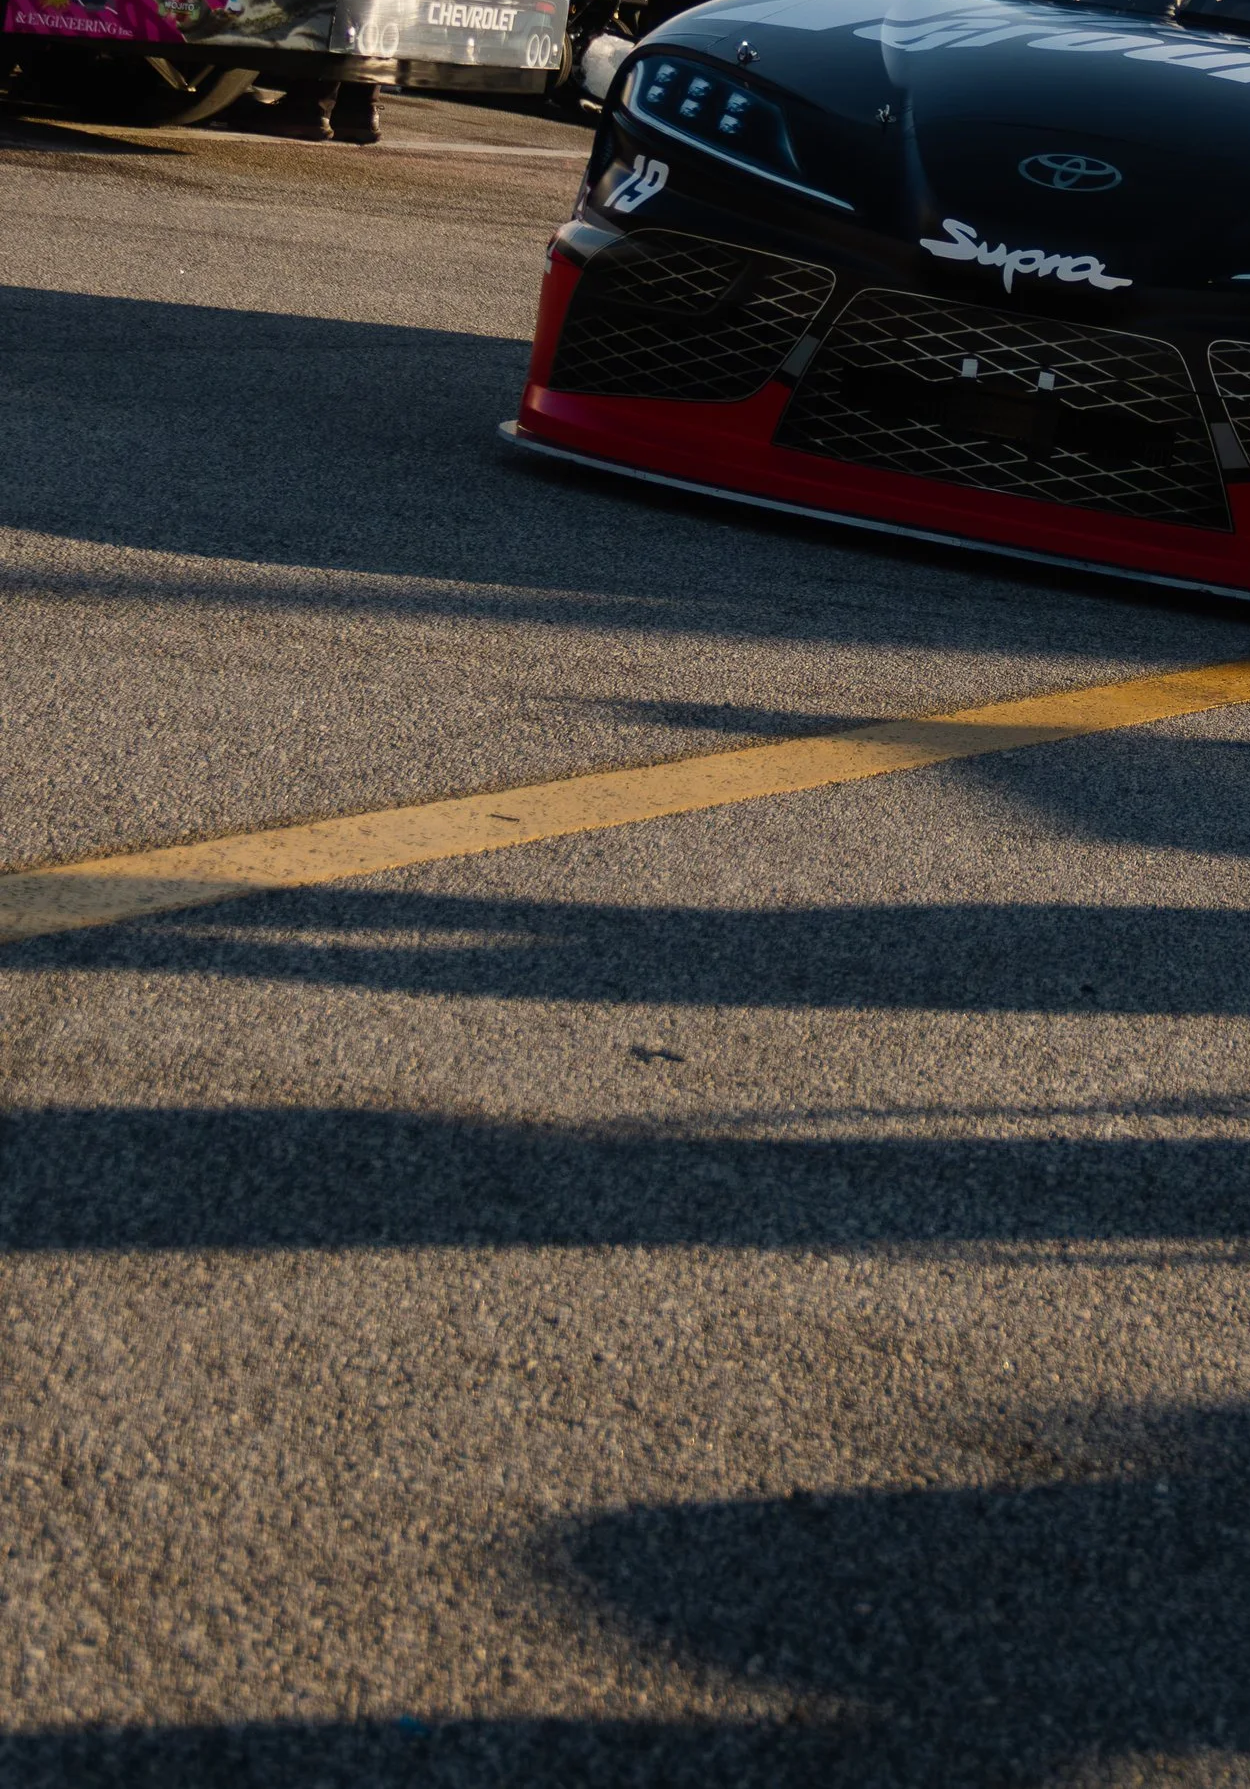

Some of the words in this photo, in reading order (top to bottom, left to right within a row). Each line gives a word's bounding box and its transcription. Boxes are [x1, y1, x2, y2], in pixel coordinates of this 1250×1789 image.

[164, 0, 196, 12] MOJITO
[428, 3, 517, 31] CHEVROLET
[28, 13, 118, 37] ENGINEERING
[604, 154, 670, 213] 19
[919, 218, 1133, 294] Supra
